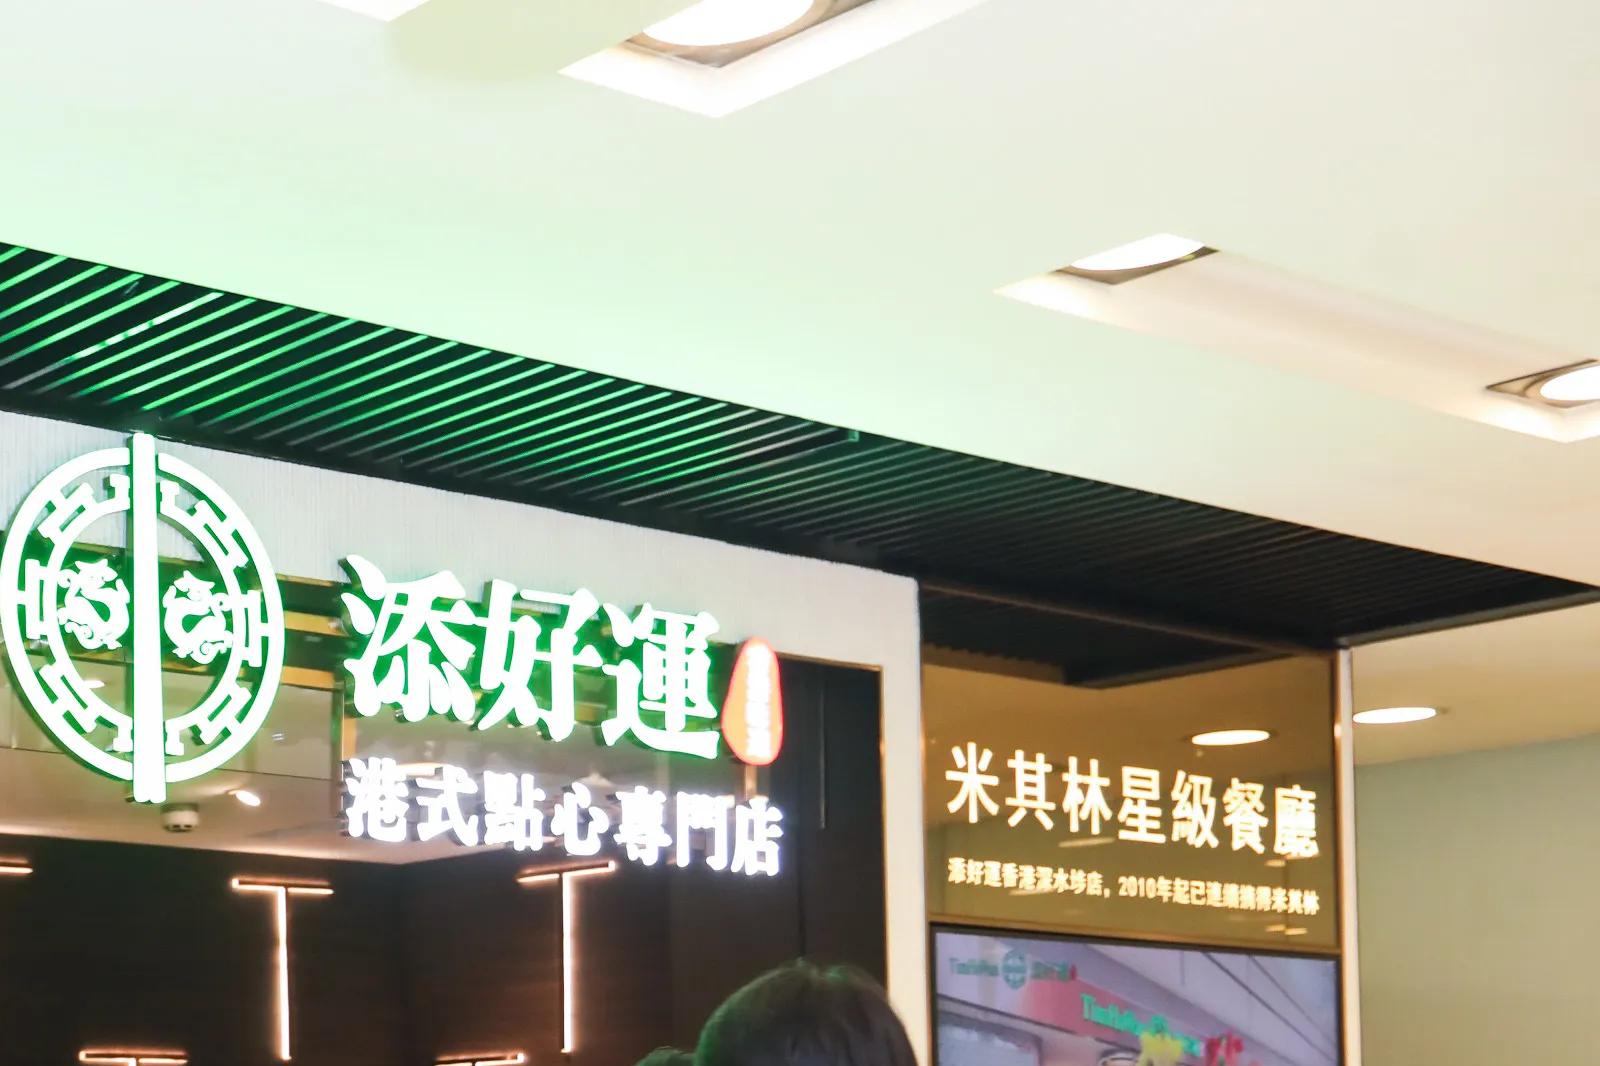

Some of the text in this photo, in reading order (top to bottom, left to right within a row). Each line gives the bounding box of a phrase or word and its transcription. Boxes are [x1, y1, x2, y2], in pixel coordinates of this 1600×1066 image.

[341, 553, 721, 760] 添好運
[343, 755, 786, 878] 港式點心專門店
